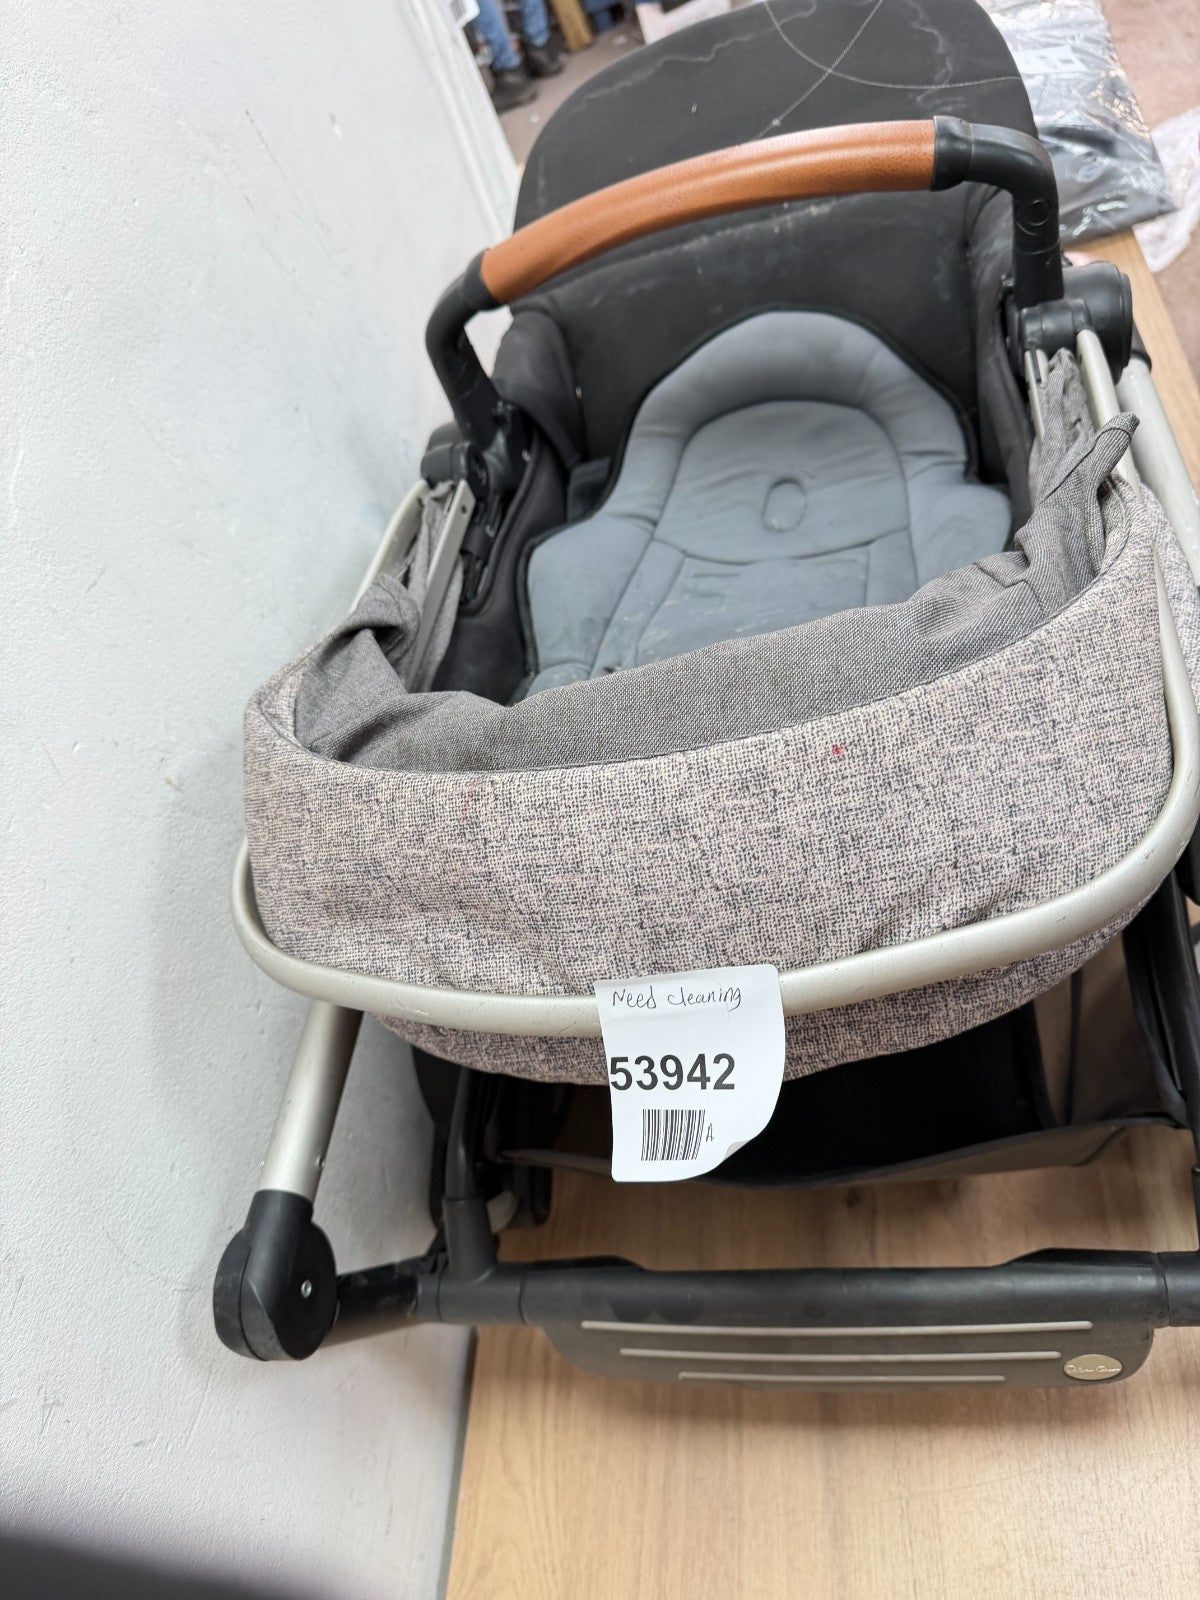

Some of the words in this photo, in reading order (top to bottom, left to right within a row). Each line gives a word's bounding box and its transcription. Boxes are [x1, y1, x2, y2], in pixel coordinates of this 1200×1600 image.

[612, 985, 657, 1010] Need
[610, 1053, 735, 1091] 53942
[705, 1122, 714, 1142] A
